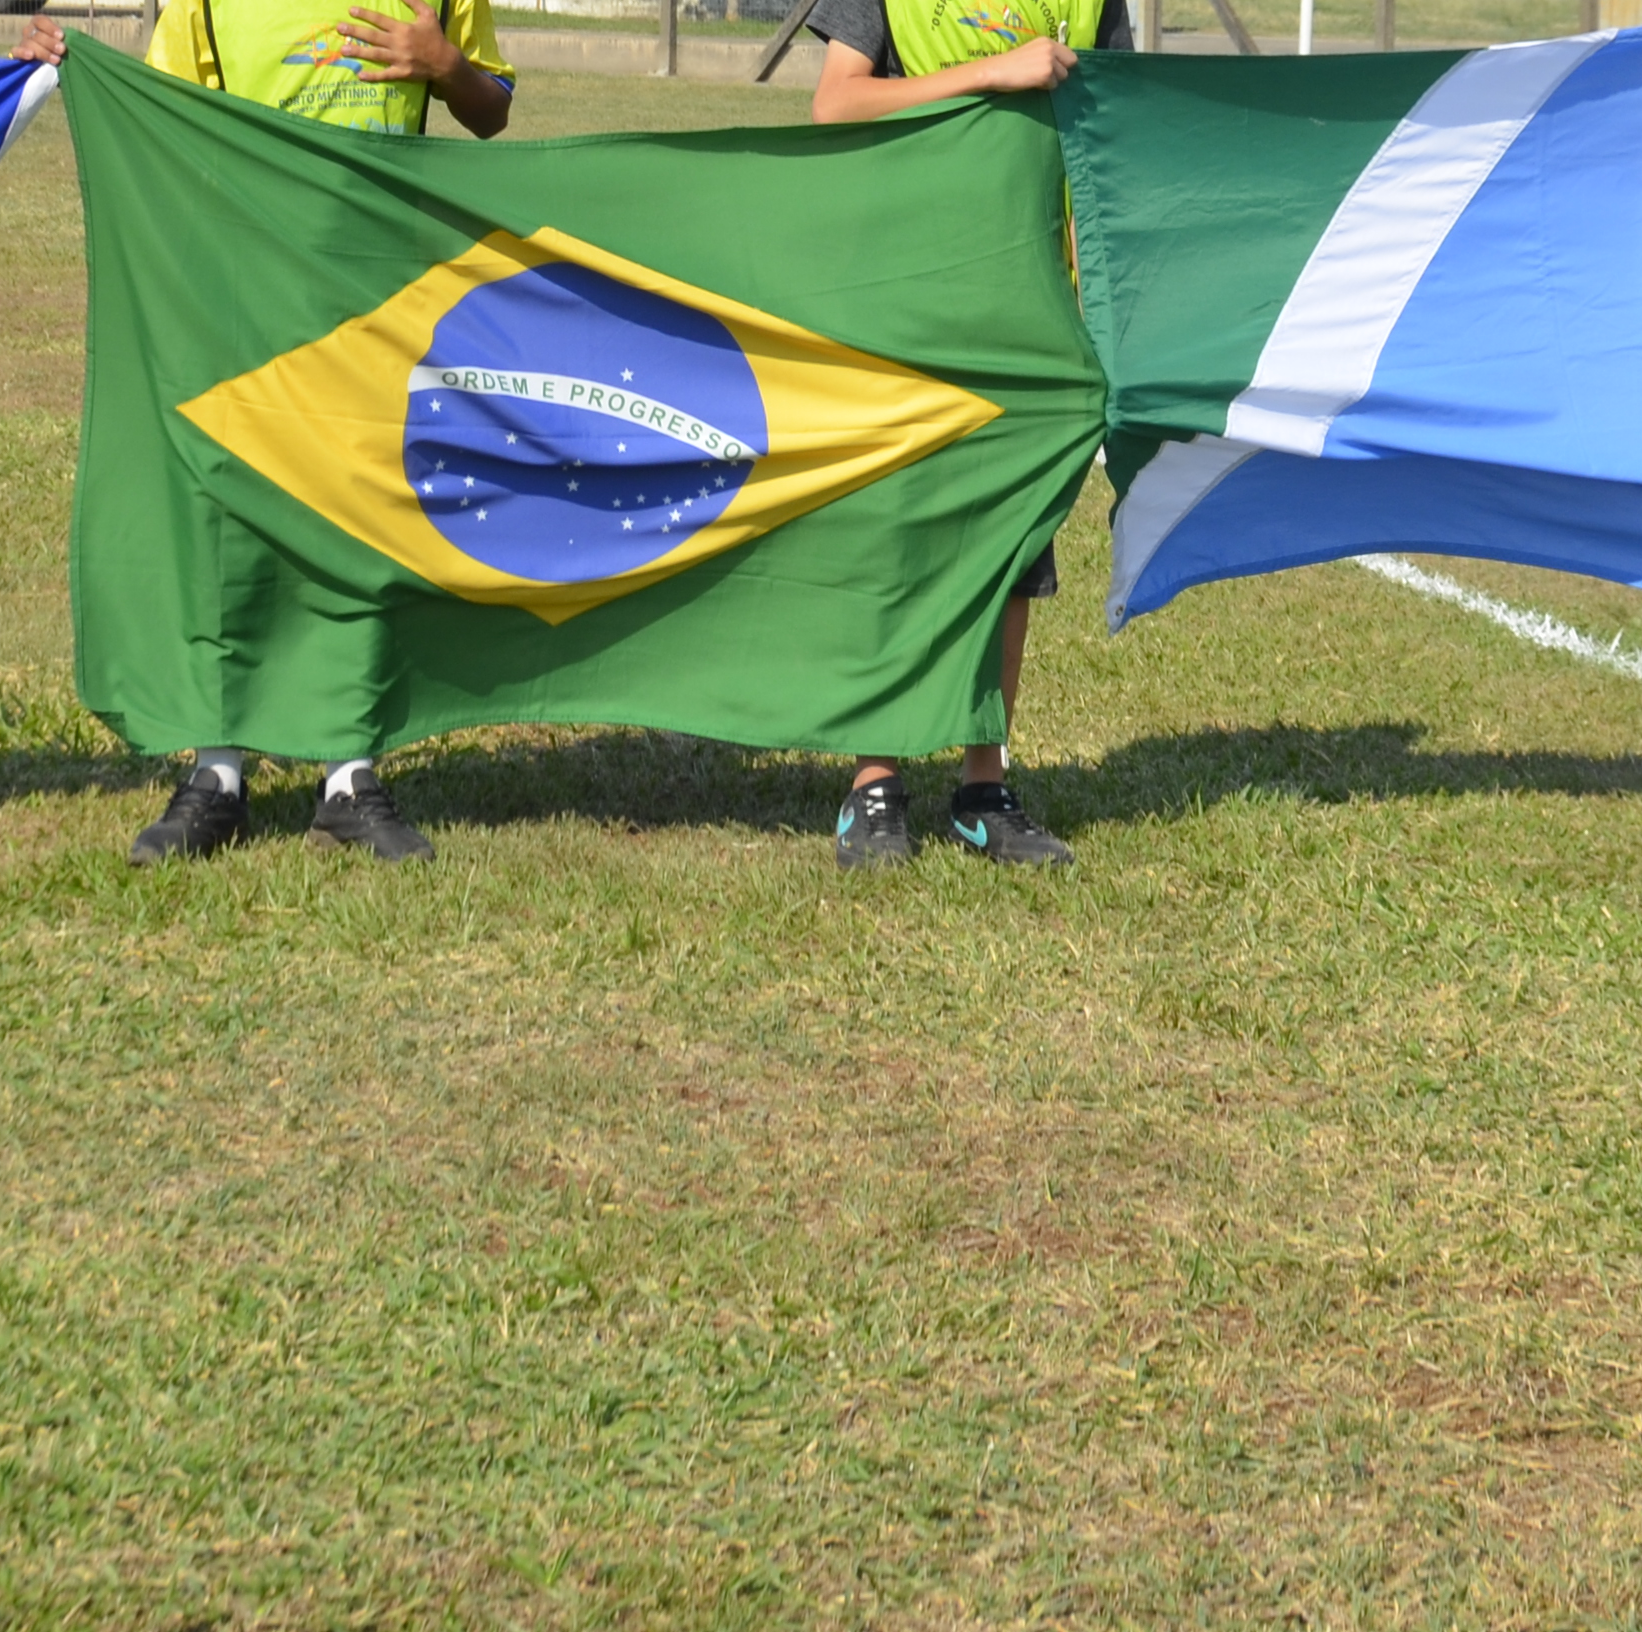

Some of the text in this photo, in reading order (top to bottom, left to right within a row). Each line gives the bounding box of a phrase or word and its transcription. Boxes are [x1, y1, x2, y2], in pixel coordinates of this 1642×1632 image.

[279, 93, 315, 110] PORTO
[317, 87, 378, 103] MURTINHO
[441, 371, 742, 461] ORDEM E PROGRESSO
